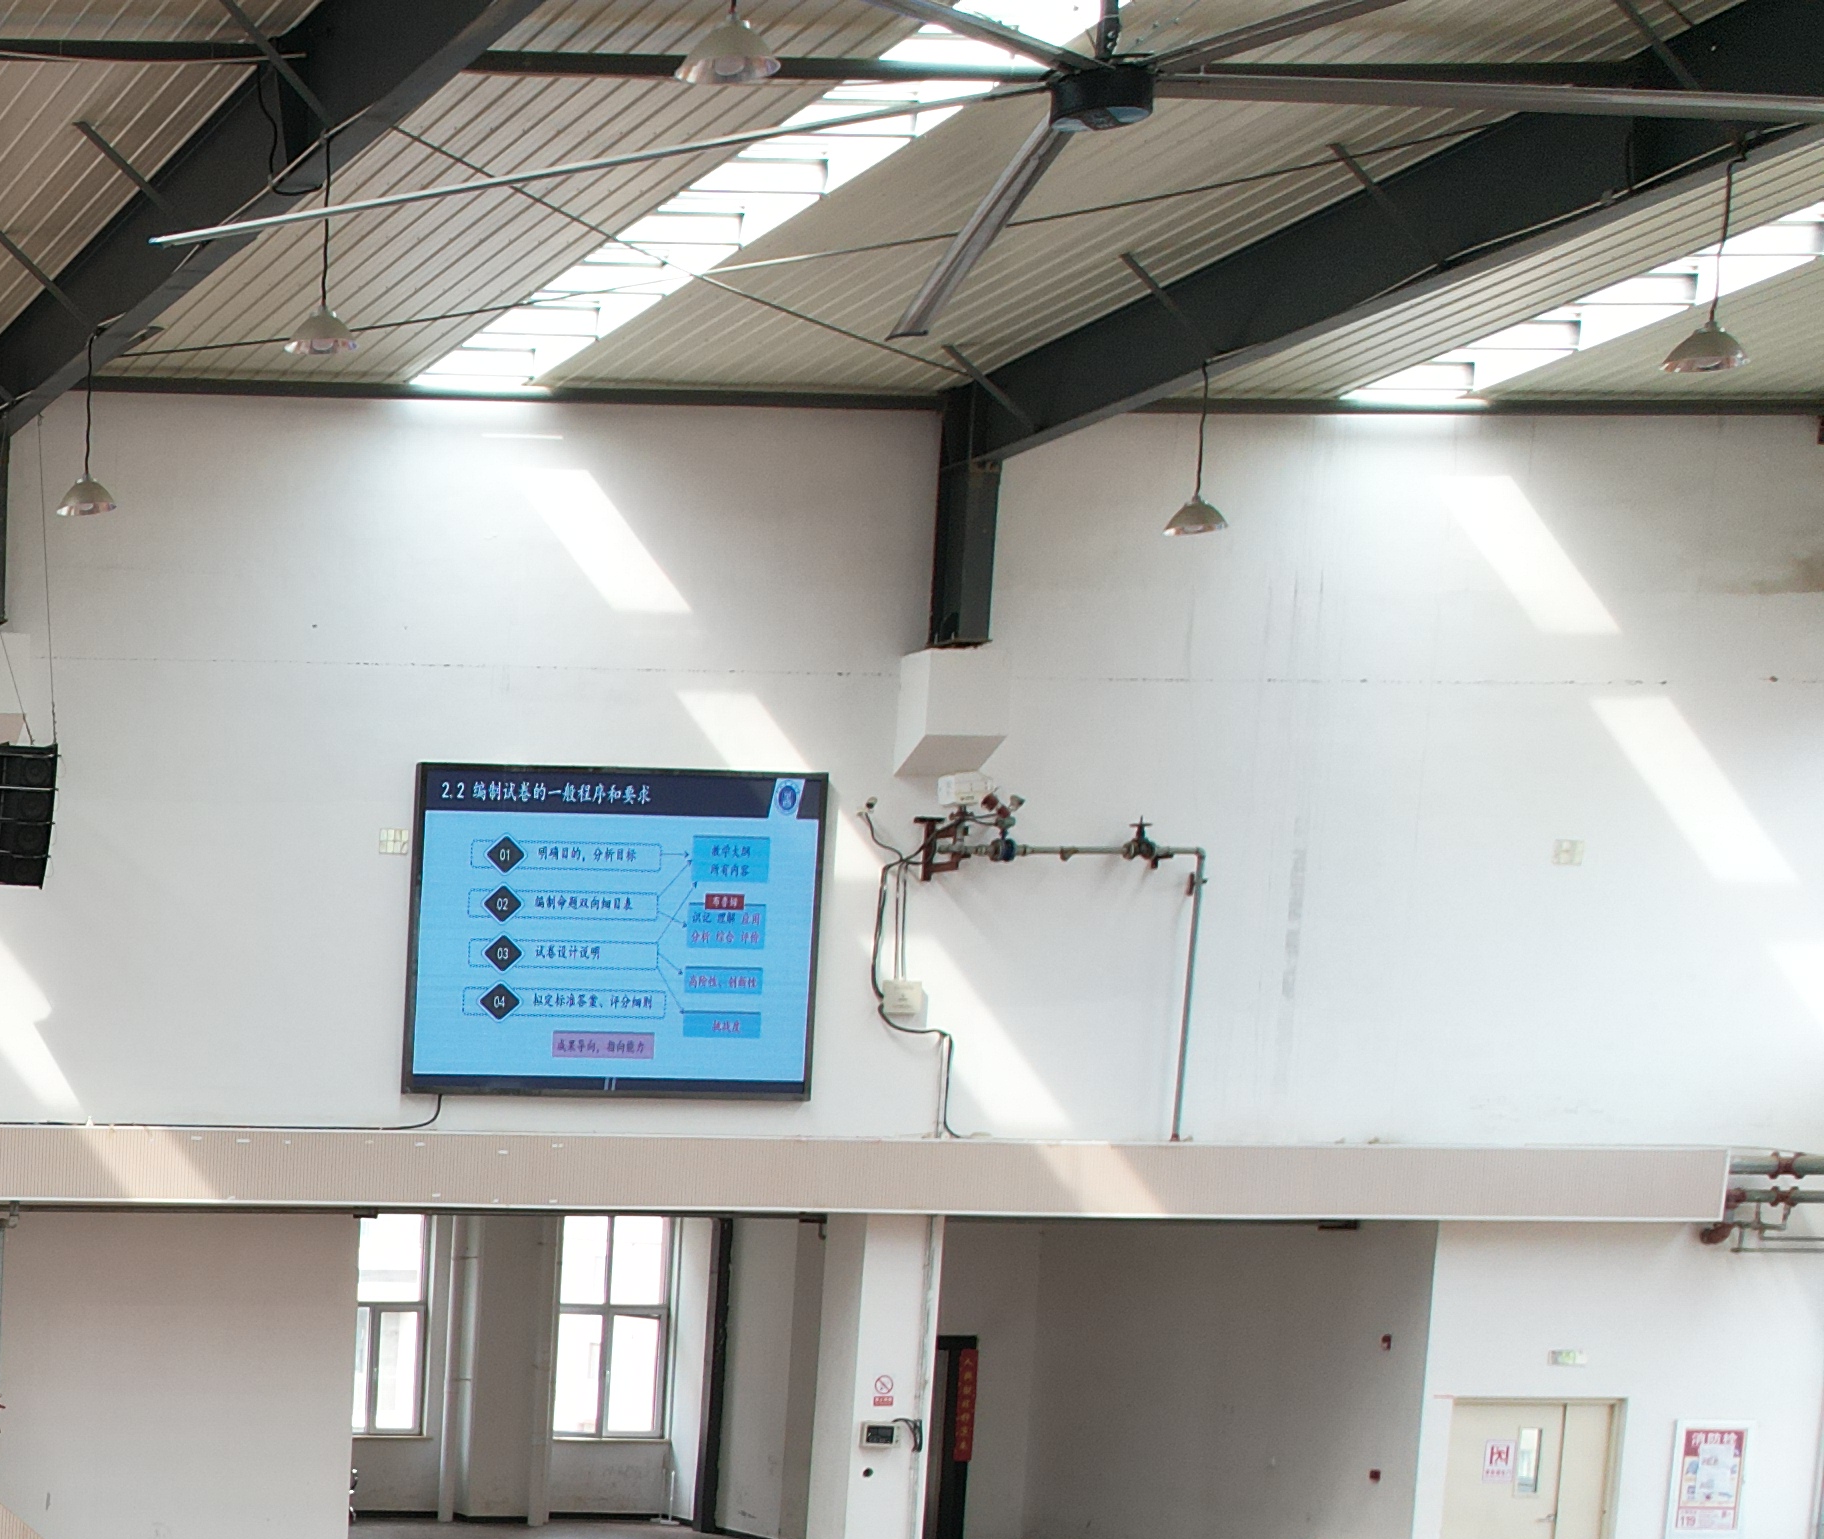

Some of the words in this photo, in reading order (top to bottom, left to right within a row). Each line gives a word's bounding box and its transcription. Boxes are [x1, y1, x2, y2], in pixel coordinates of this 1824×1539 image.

[441, 781, 465, 800] 2.2
[472, 780, 652, 804] 编制试卷的一般程序和要求
[499, 848, 510, 861] 01
[496, 897, 509, 911] 02
[497, 947, 509, 960] 03
[493, 995, 505, 1008] 04
